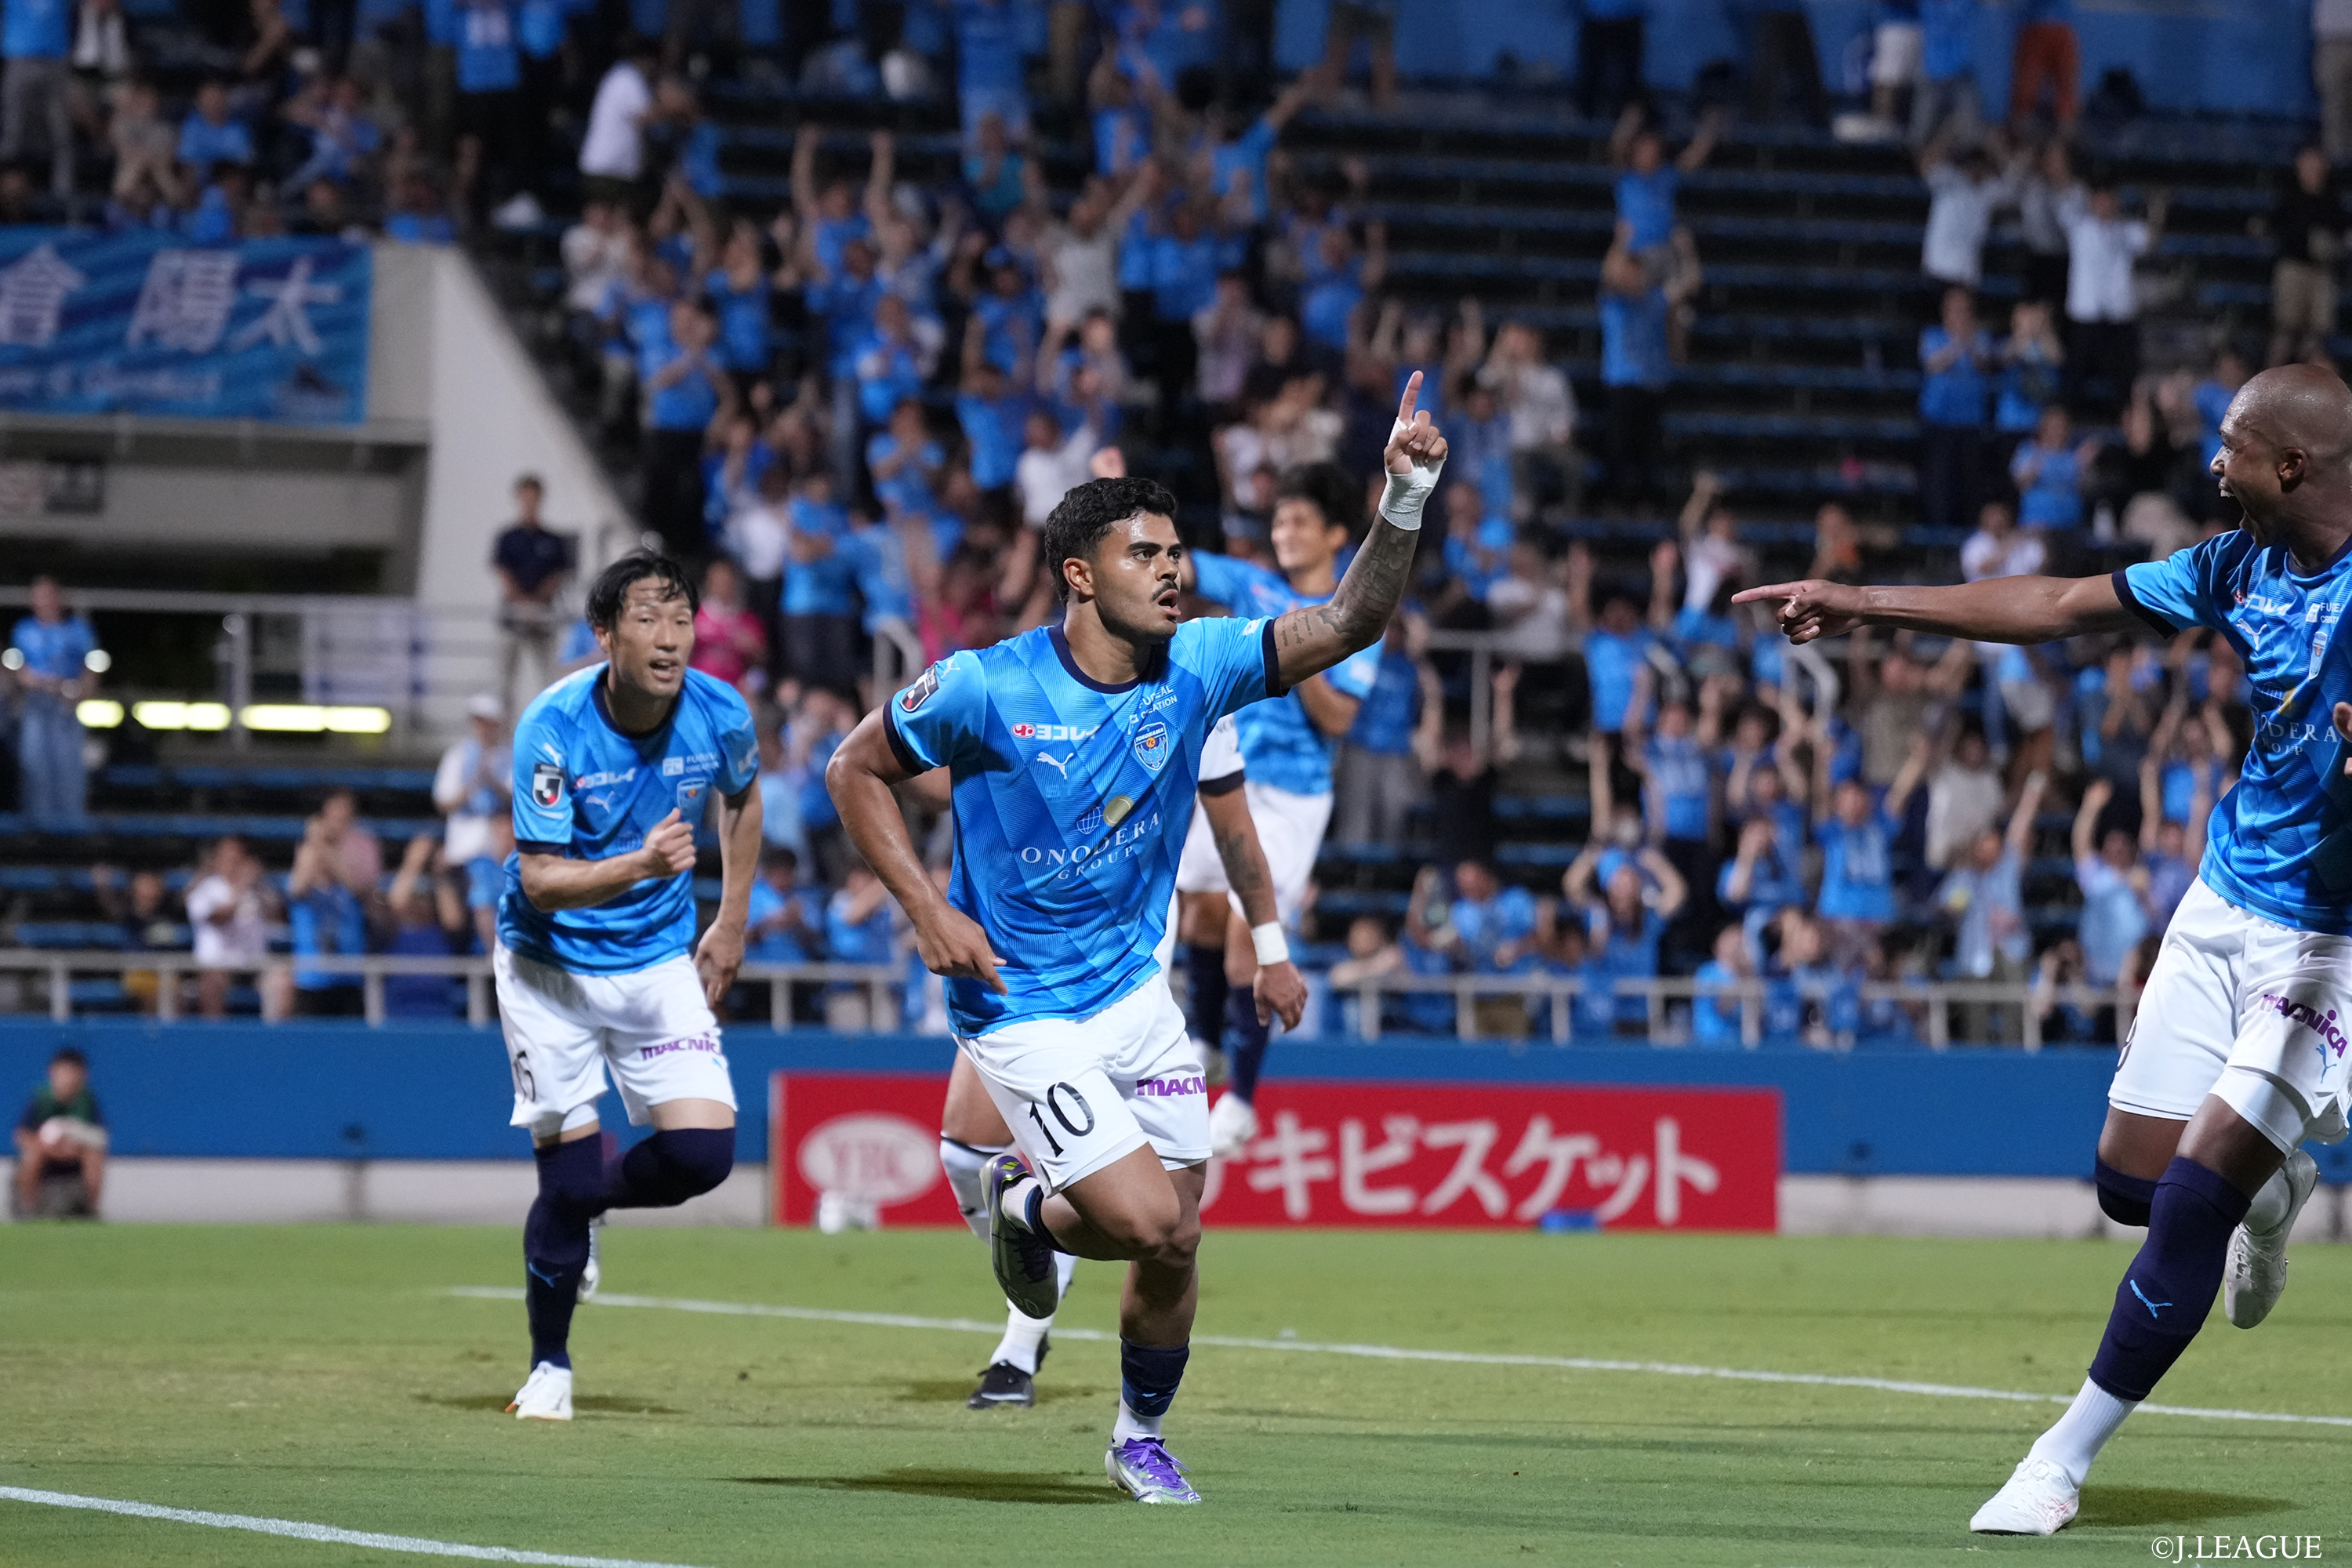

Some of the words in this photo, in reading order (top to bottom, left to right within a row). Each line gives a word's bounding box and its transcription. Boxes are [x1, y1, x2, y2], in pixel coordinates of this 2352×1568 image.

[1021, 811, 1160, 866] ONODERA
[1058, 845, 1134, 880] GROUP
[1029, 1081, 1095, 1158] 10
